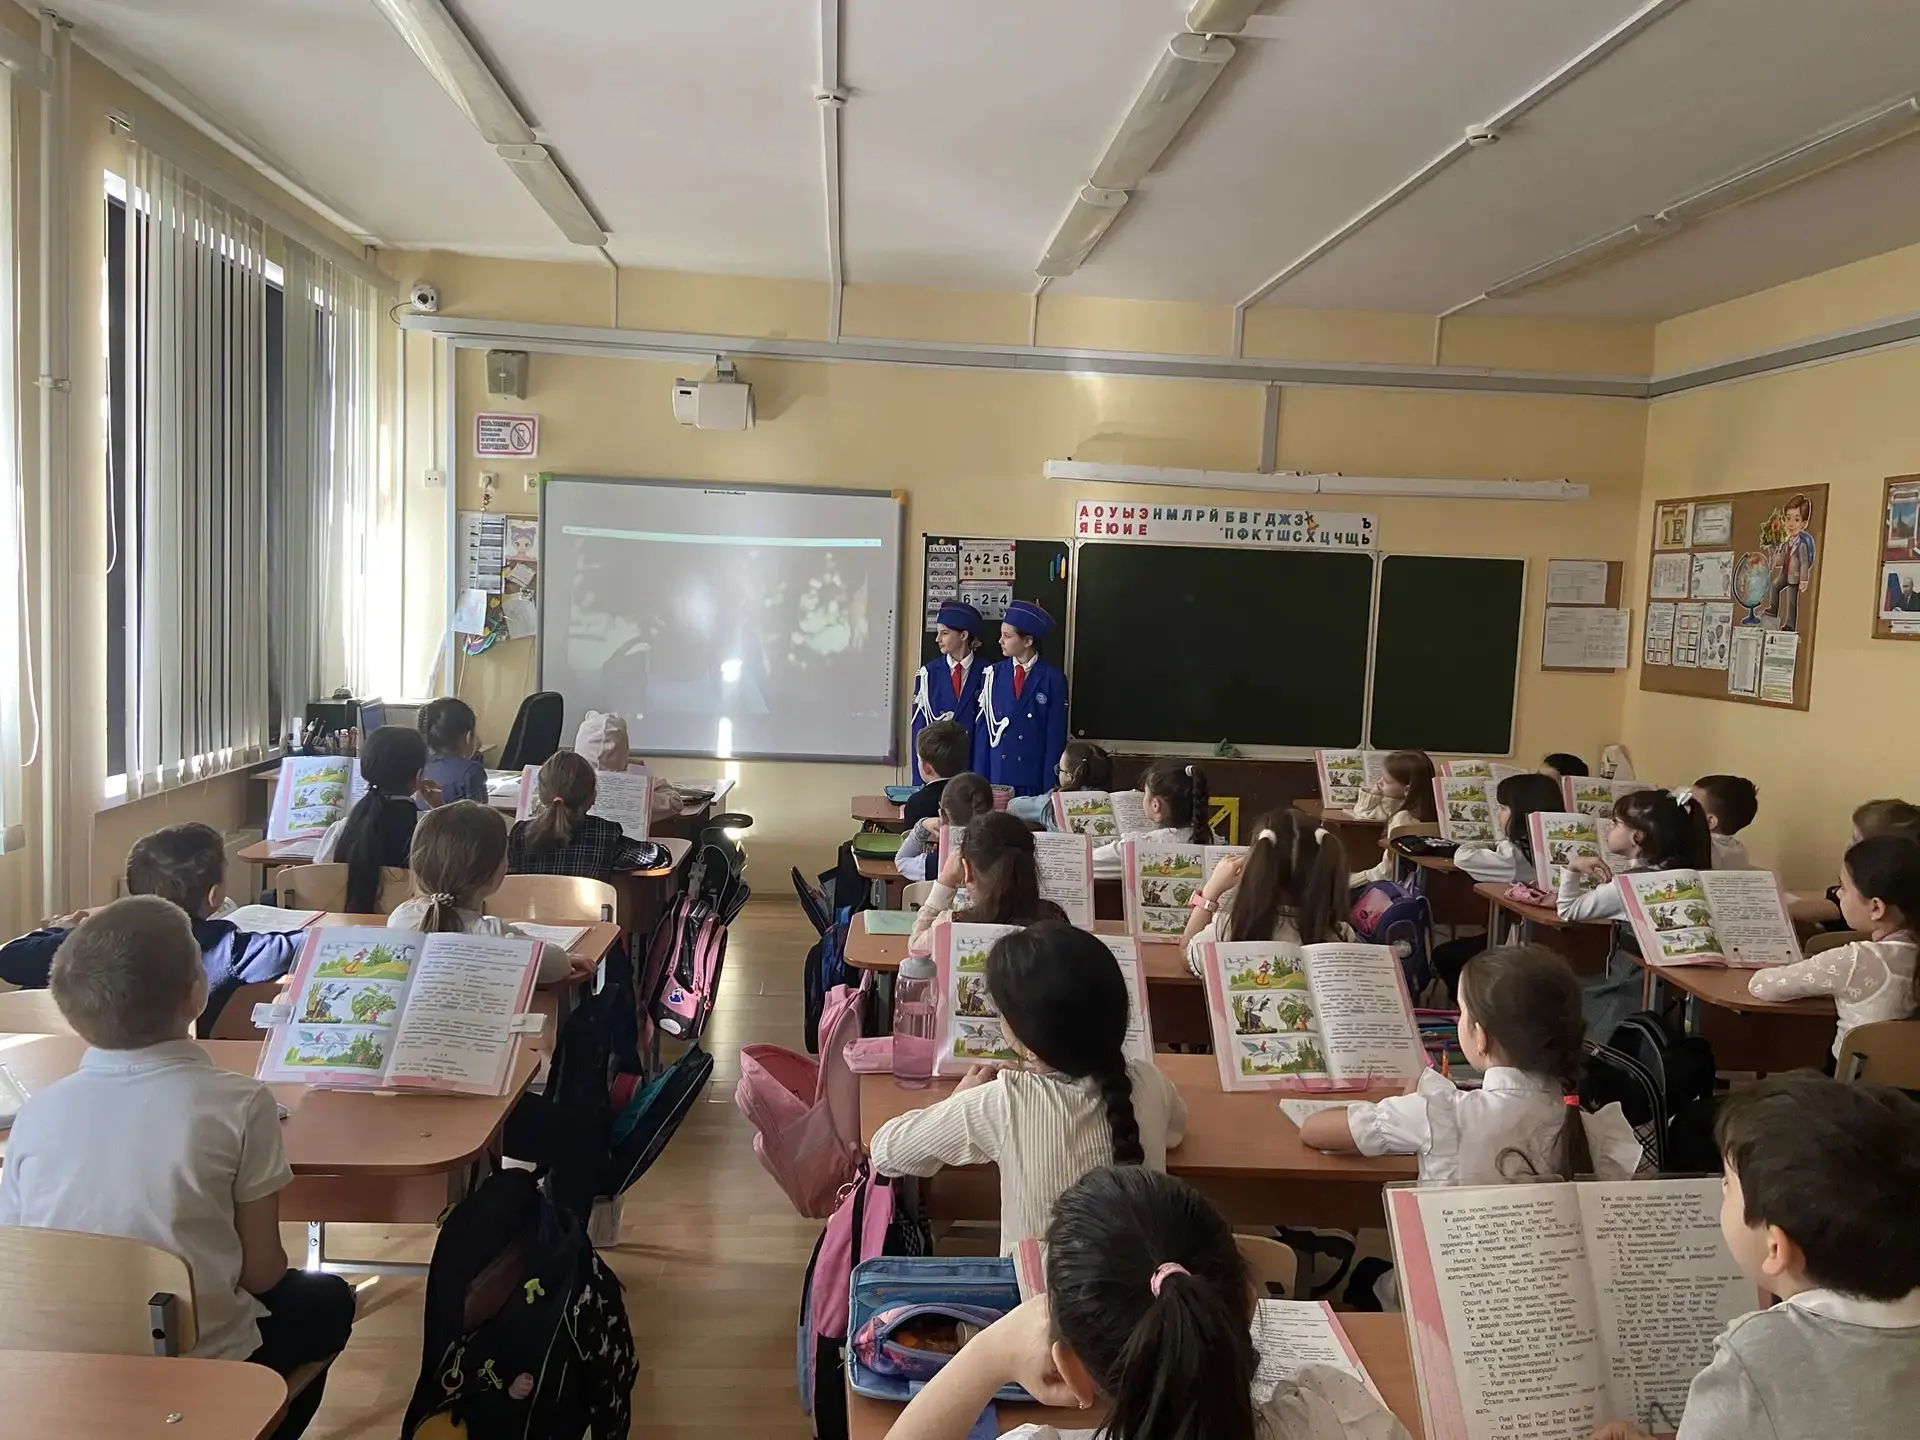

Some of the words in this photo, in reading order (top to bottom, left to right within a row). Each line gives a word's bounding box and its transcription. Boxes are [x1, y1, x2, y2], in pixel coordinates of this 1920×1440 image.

[965, 553, 972, 564] 4
[983, 553, 990, 564] 2
[1003, 553, 1009, 564] 6
[964, 594, 971, 604] 6
[982, 594, 989, 604] 2
[1000, 594, 1007, 604] 4
